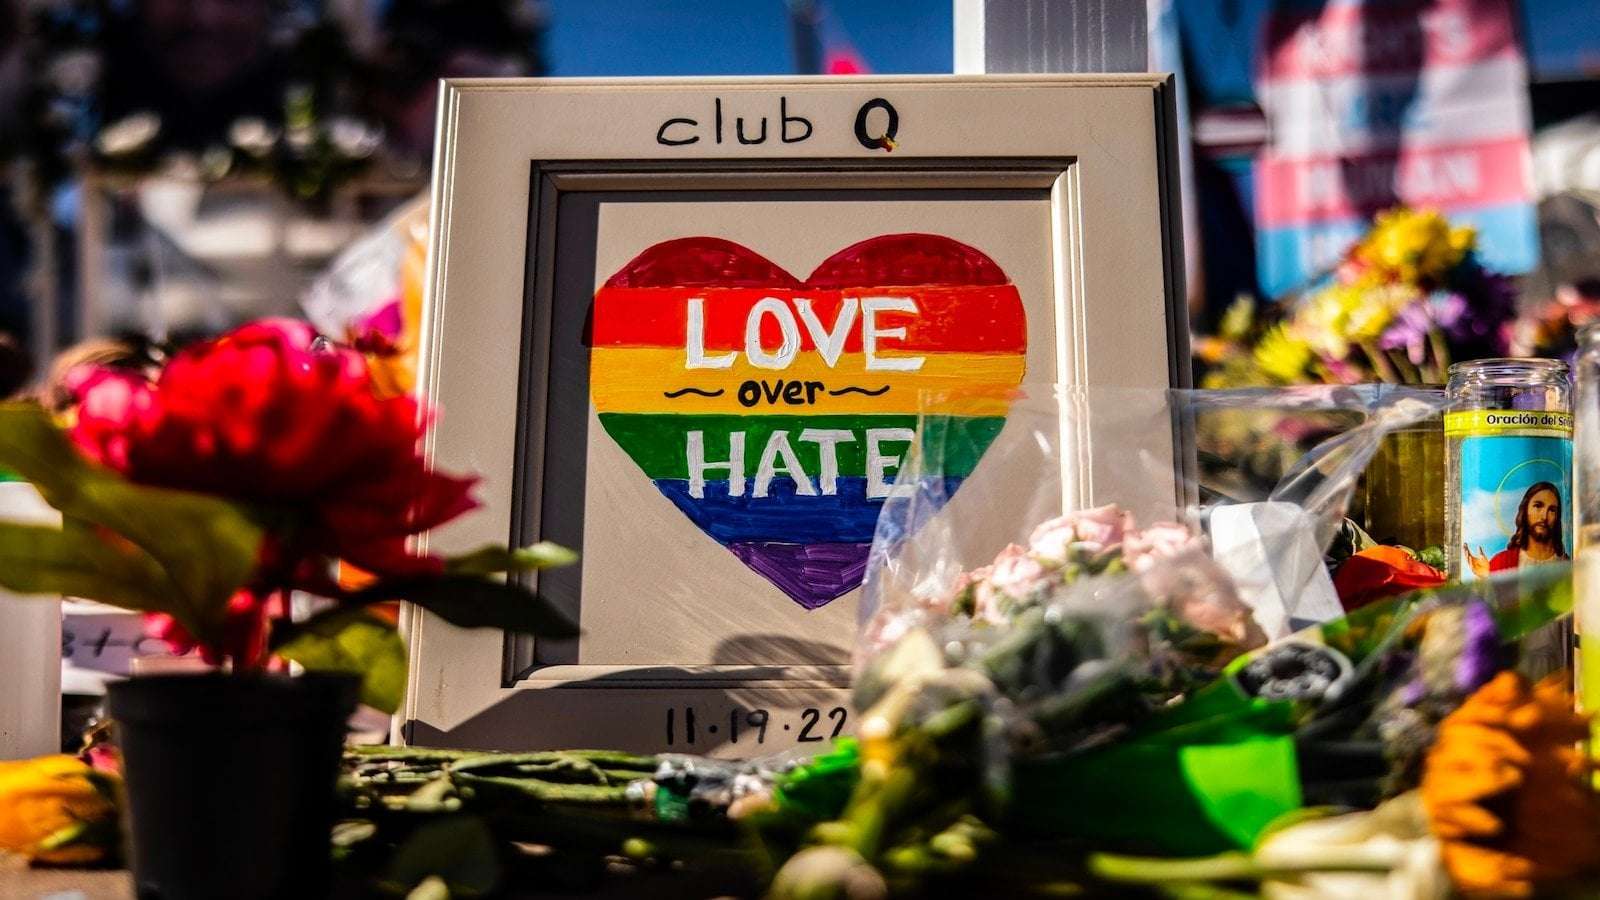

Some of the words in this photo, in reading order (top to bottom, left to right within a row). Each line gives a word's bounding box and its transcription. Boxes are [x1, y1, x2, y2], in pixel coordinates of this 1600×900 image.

[656, 96, 813, 145] club
[854, 97, 899, 152] Q
[685, 296, 926, 371] LOVE
[737, 379, 825, 408] over
[1540, 414, 1556, 426] del
[685, 428, 918, 501] HATE
